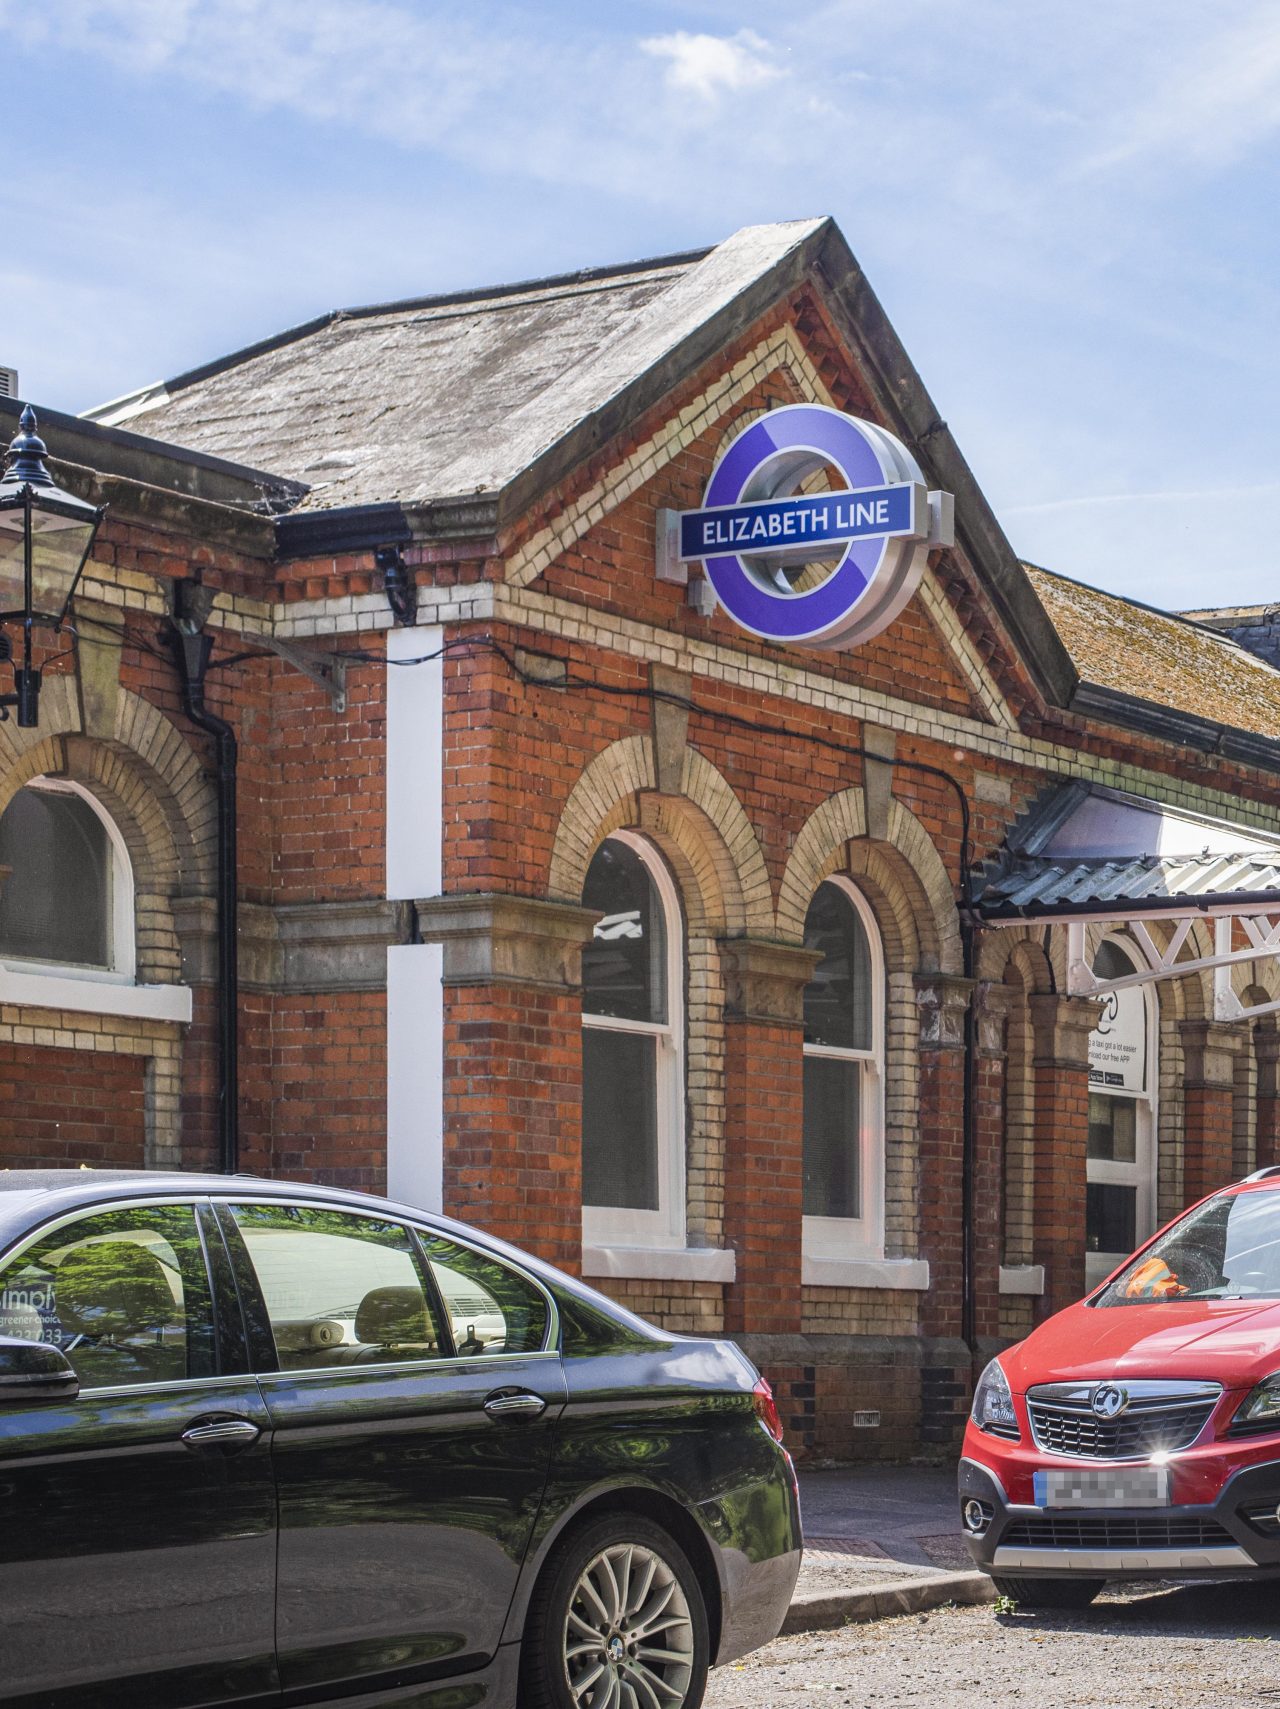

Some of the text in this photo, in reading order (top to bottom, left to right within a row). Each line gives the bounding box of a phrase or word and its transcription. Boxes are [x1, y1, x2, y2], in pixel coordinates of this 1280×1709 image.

[703, 499, 889, 545] ELIZABETH LINE
[1110, 1053, 1119, 1062] free
[0, 1316, 32, 1327] greener
